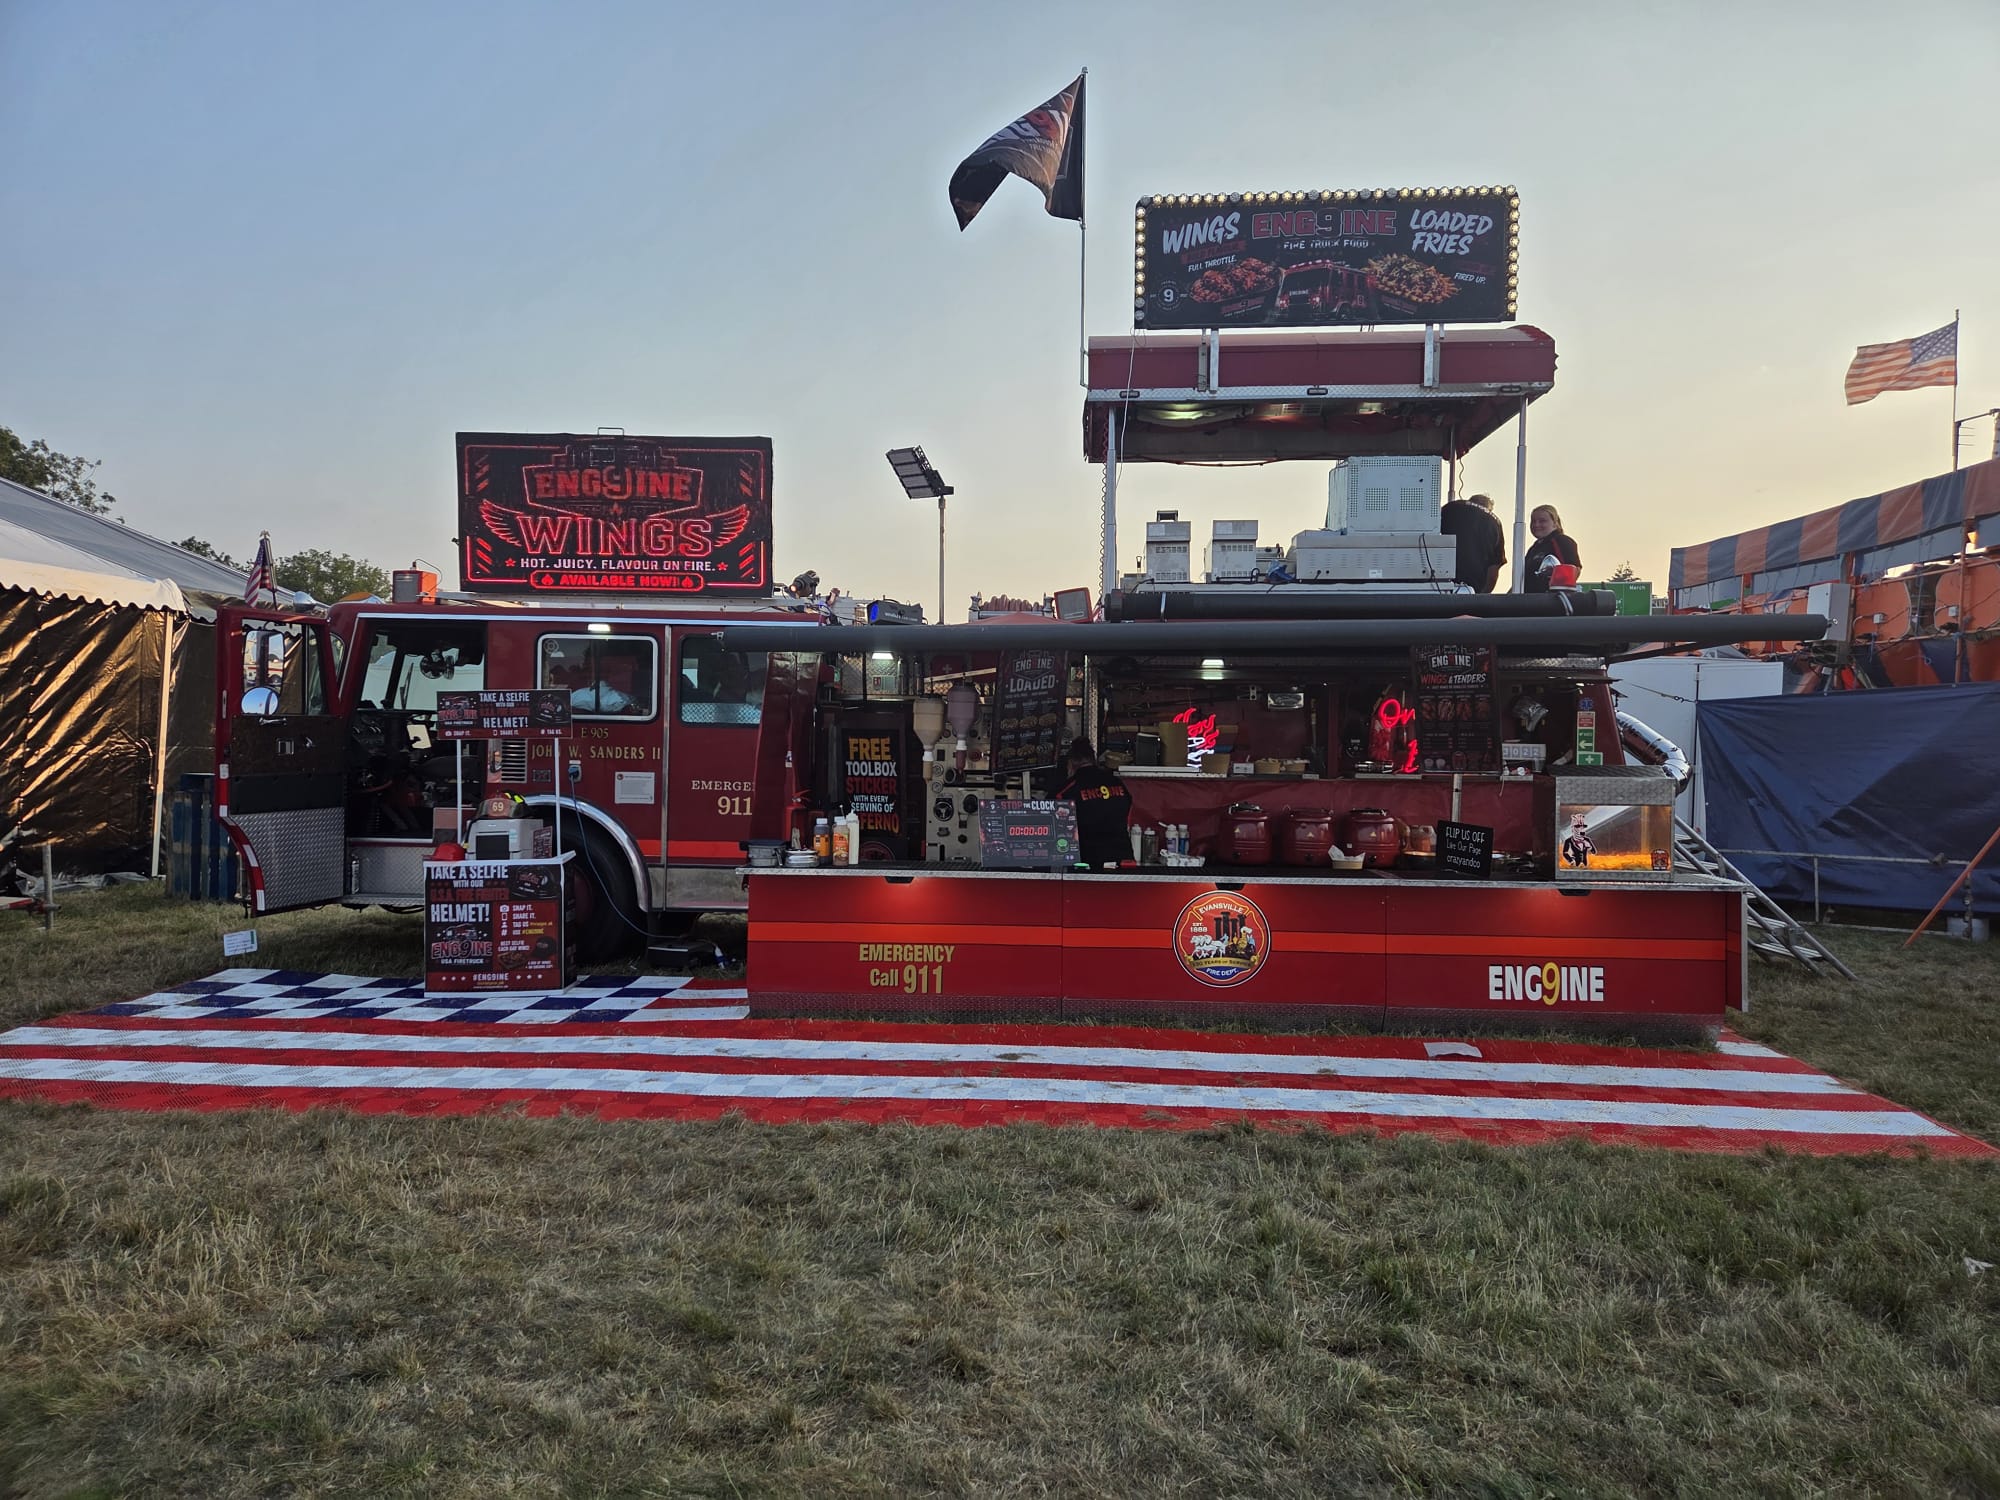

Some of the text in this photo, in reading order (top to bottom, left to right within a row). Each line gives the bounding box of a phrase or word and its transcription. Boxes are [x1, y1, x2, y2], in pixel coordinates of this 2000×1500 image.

[1252, 208, 1396, 239] ENG9INE
[1410, 209, 1493, 235] LOADED
[1163, 212, 1240, 254] WINGS
[1284, 241, 1305, 249] FIRE
[1344, 240, 1368, 248] FOOD
[1412, 232, 1474, 255] FRIES
[1188, 261, 1202, 272] FULL
[1454, 273, 1474, 282] FIRED
[1164, 289, 1174, 302] 9
[534, 466, 692, 500] ENG9INE
[516, 516, 713, 557] WINGS
[520, 558, 715, 572] HOT. JUICY. FLAVOUR ON FIRE.
[560, 574, 634, 586] AVAILABLE
[1010, 675, 1055, 692] LOADED
[1421, 674, 1448, 685] WINGS
[1454, 673, 1486, 684] TENDERS
[479, 692, 530, 702] TAKE A SELFIE
[483, 717, 528, 728] HELMET!
[581, 728, 608, 738] E 905
[532, 745, 560, 759] JOH
[568, 746, 582, 758] W.
[590, 746, 644, 760] SANDERS
[848, 737, 891, 760] FREE
[846, 761, 897, 776] TOOLBOX
[692, 780, 755, 792] EMERGE
[846, 778, 897, 794] STICKER
[492, 802, 504, 812] 69
[718, 796, 752, 816] 911
[850, 802, 894, 813] SERVING OF
[1001, 801, 1022, 810] STOP
[1032, 800, 1055, 810] CLOCK
[860, 813, 899, 834] FERNO
[1010, 826, 1048, 836] 00:00.00
[1446, 826, 1486, 844] FLIP US OFF
[430, 865, 508, 880] TAKE A SELFIE
[453, 880, 484, 888] WITH OUR
[430, 904, 490, 922] HELMET!
[1199, 903, 1243, 914] EVANSVILLE
[859, 944, 955, 962] EMERGENCY
[870, 964, 943, 994] Call 911
[1206, 968, 1220, 976] FIRE
[1488, 962, 1604, 1006] ENG9INE
